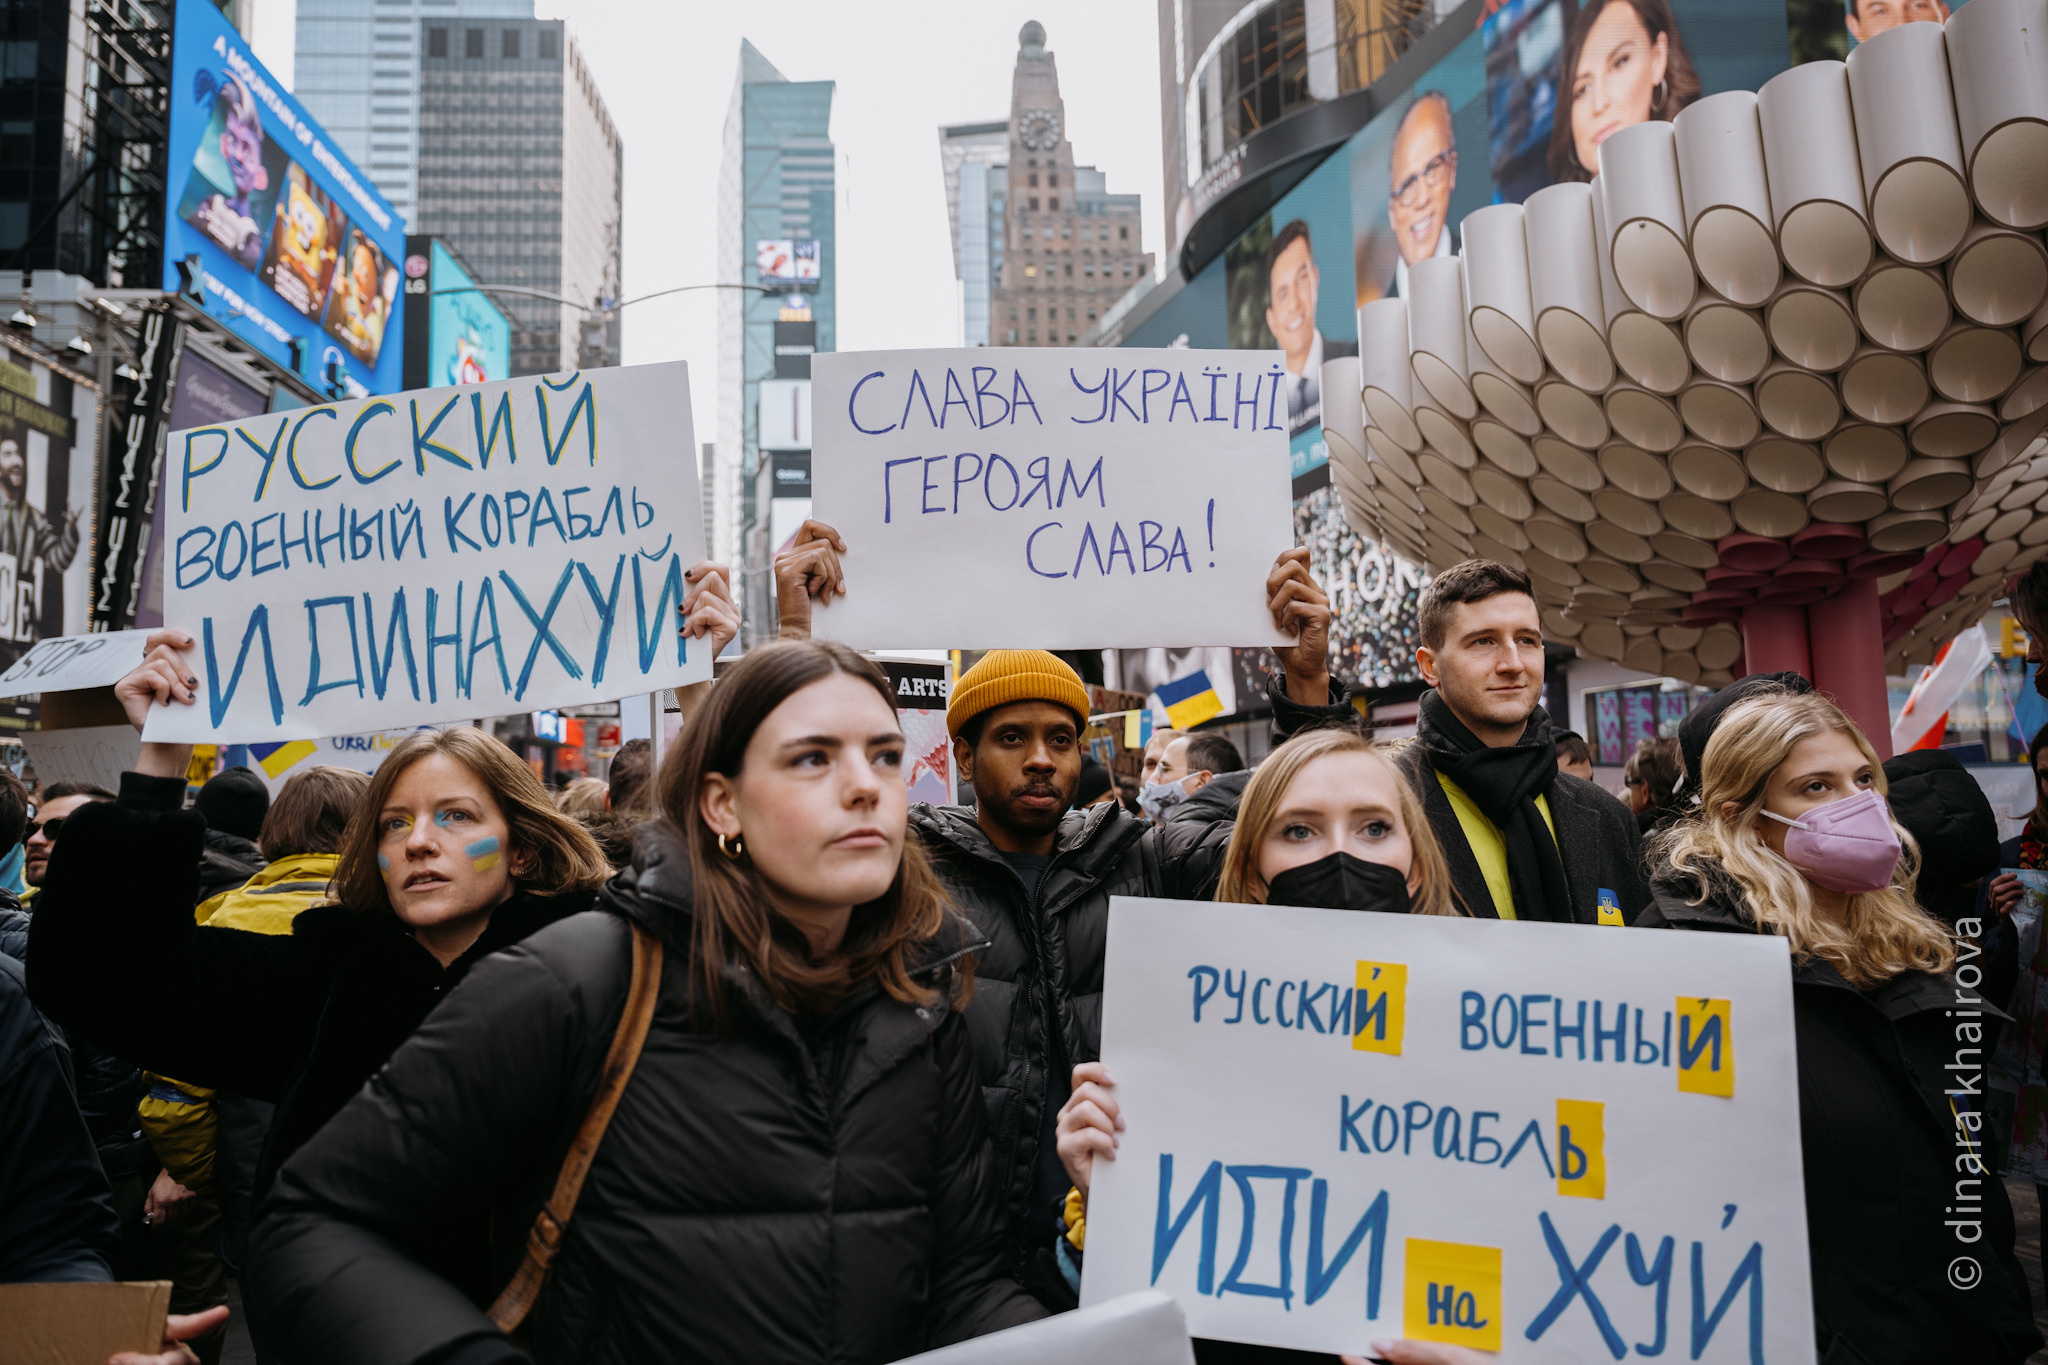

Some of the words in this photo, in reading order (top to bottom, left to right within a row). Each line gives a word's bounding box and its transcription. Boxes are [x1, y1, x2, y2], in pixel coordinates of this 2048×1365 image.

[405, 278, 428, 295] LG
[848, 366, 1043, 435] СЛАВА
[1070, 364, 1286, 432] УКРАЇНІ
[182, 371, 599, 513] РУССКИЙ
[884, 453, 1106, 524] ГЕРОЯМ
[175, 498, 427, 590] ВОЕННЫЙ
[444, 485, 656, 554] КОРАБЛЬ
[1026, 497, 1216, 580] СЛАВА!
[4, 638, 106, 683] STOP
[897, 676, 947, 698] ARTS
[1186, 964, 1388, 1042] РУССКИЙ
[1460, 989, 1724, 1072] ВОЕННЫЙ
[1150, 1153, 1390, 1322] ИДИ
[1524, 1203, 1765, 1365] ХУЙ
